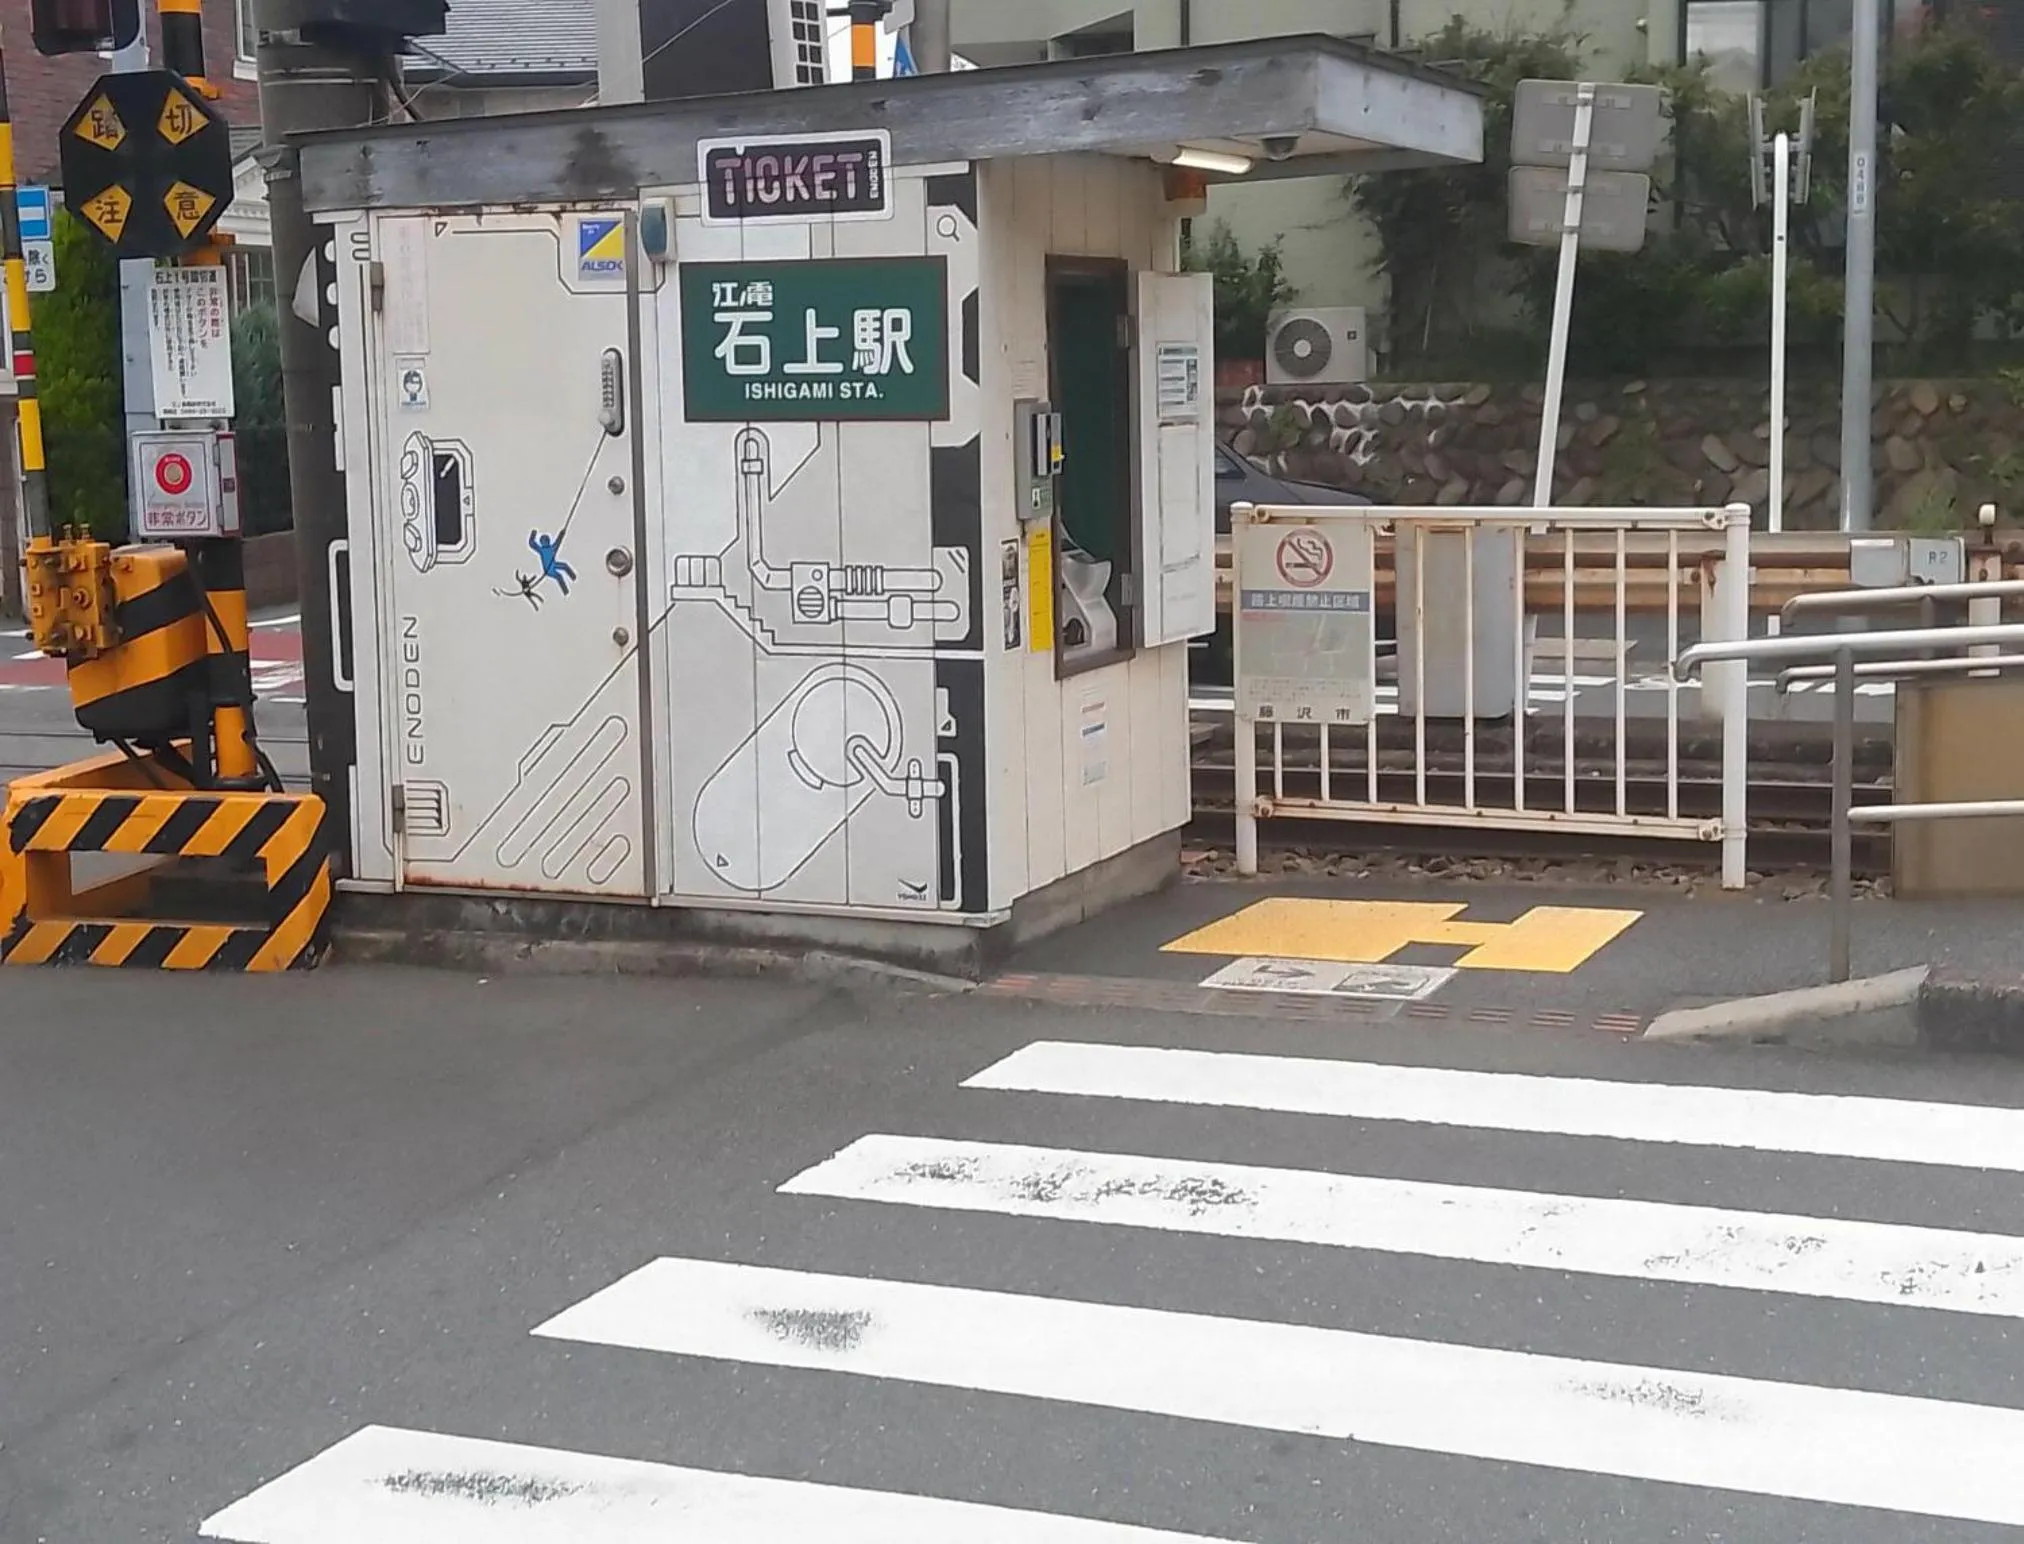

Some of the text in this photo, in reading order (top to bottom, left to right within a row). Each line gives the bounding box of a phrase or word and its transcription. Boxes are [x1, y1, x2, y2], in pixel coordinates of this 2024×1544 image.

[165, 104, 192, 135] 切
[715, 152, 863, 206] TICKET
[96, 191, 200, 224] 注 意
[581, 260, 624, 271] ALSOK
[712, 281, 774, 308] 江ノ電
[713, 308, 914, 376] 石上駅
[745, 382, 884, 400] ISHIGAMI STA.
[147, 509, 207, 526] 非常ボタン
[1928, 551, 1948, 564] R2
[402, 616, 424, 764] ENODEN
